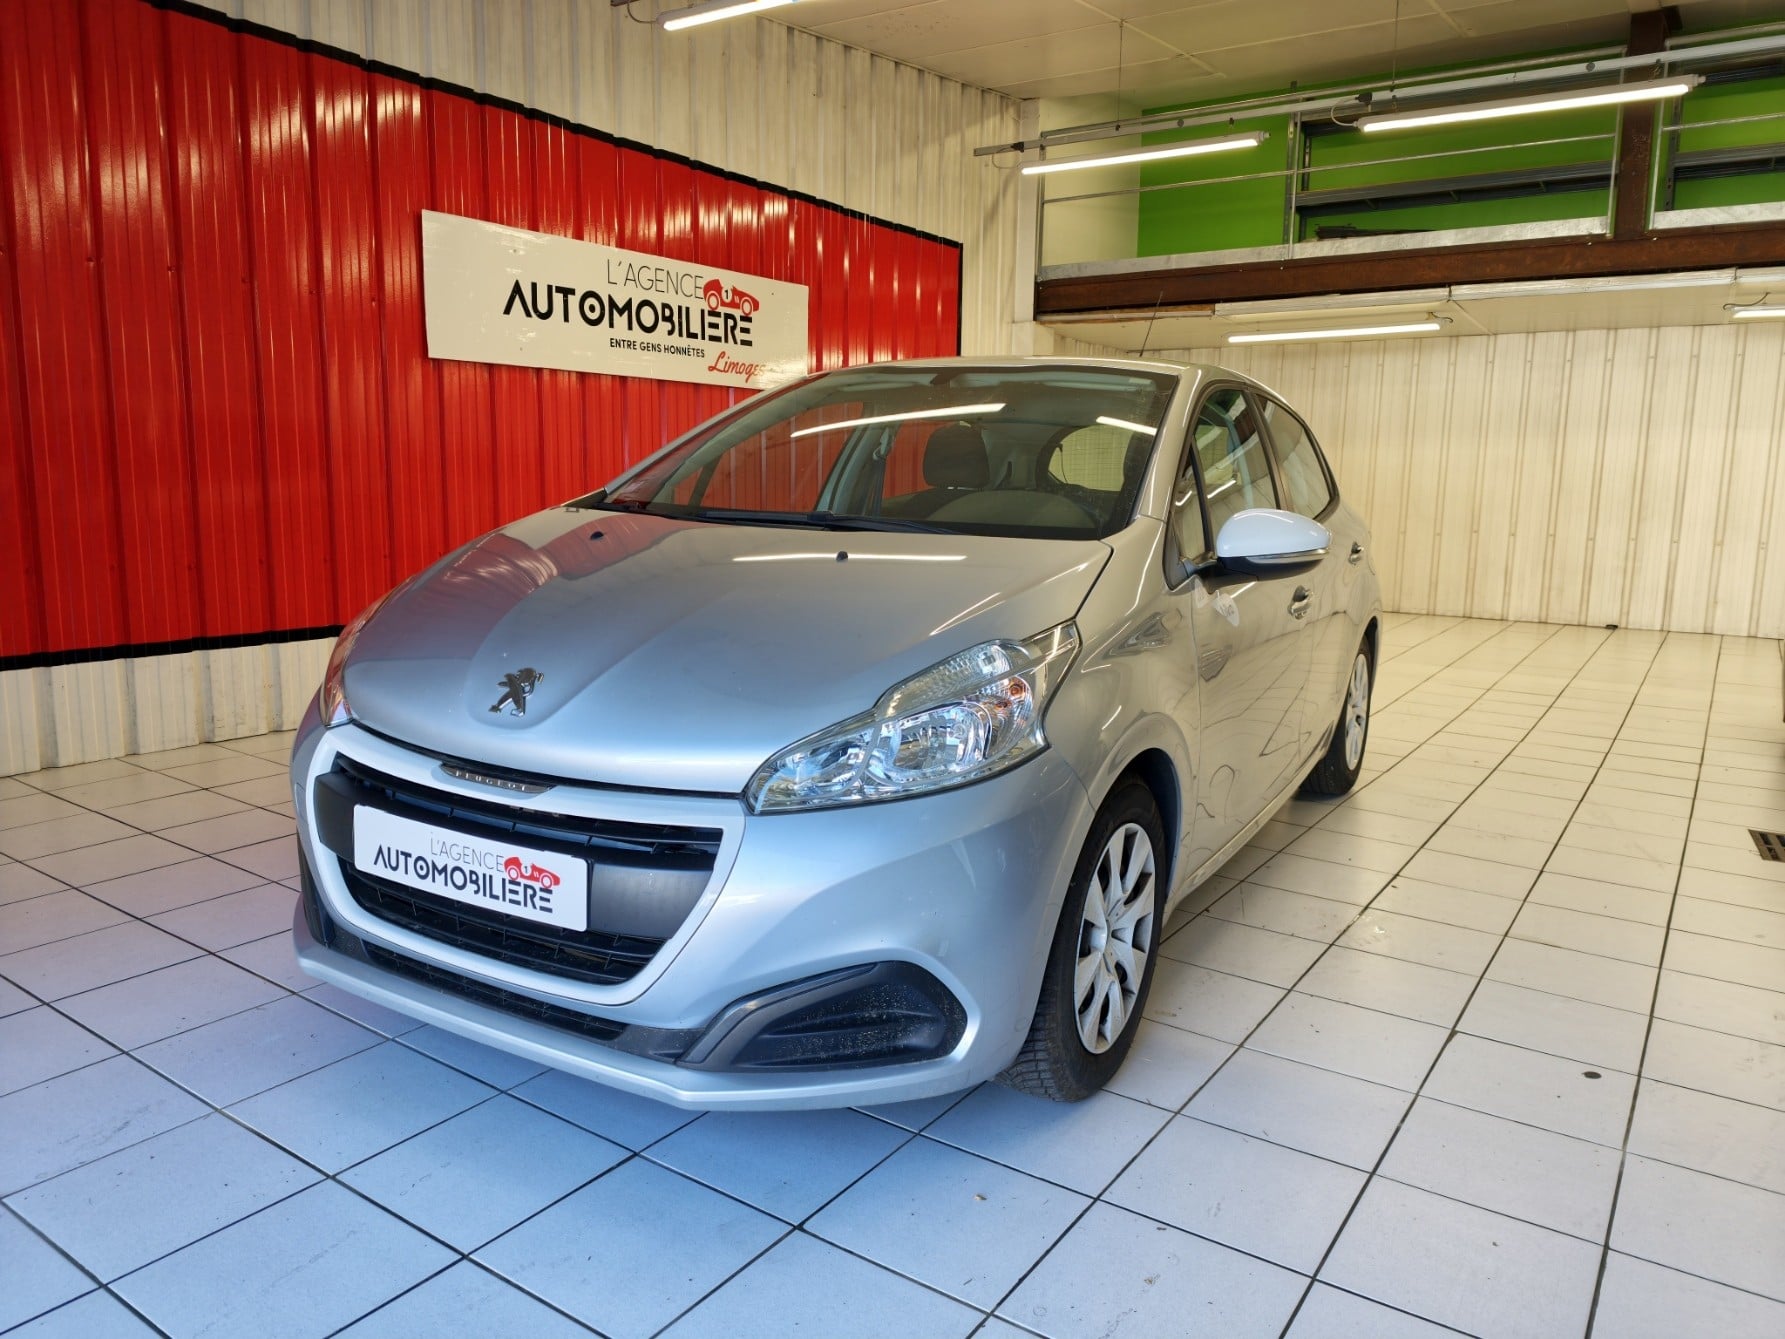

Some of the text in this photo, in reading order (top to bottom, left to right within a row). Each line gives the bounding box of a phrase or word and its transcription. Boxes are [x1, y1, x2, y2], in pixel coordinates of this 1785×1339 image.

[606, 259, 704, 300] L'AGENCE
[502, 279, 753, 347] AUTOMOBILIERE
[609, 338, 705, 358] ENTRE GENS HONNÊTES
[430, 836, 504, 873] L'AGENCE
[374, 844, 553, 914] AUTOMOBILIERE
